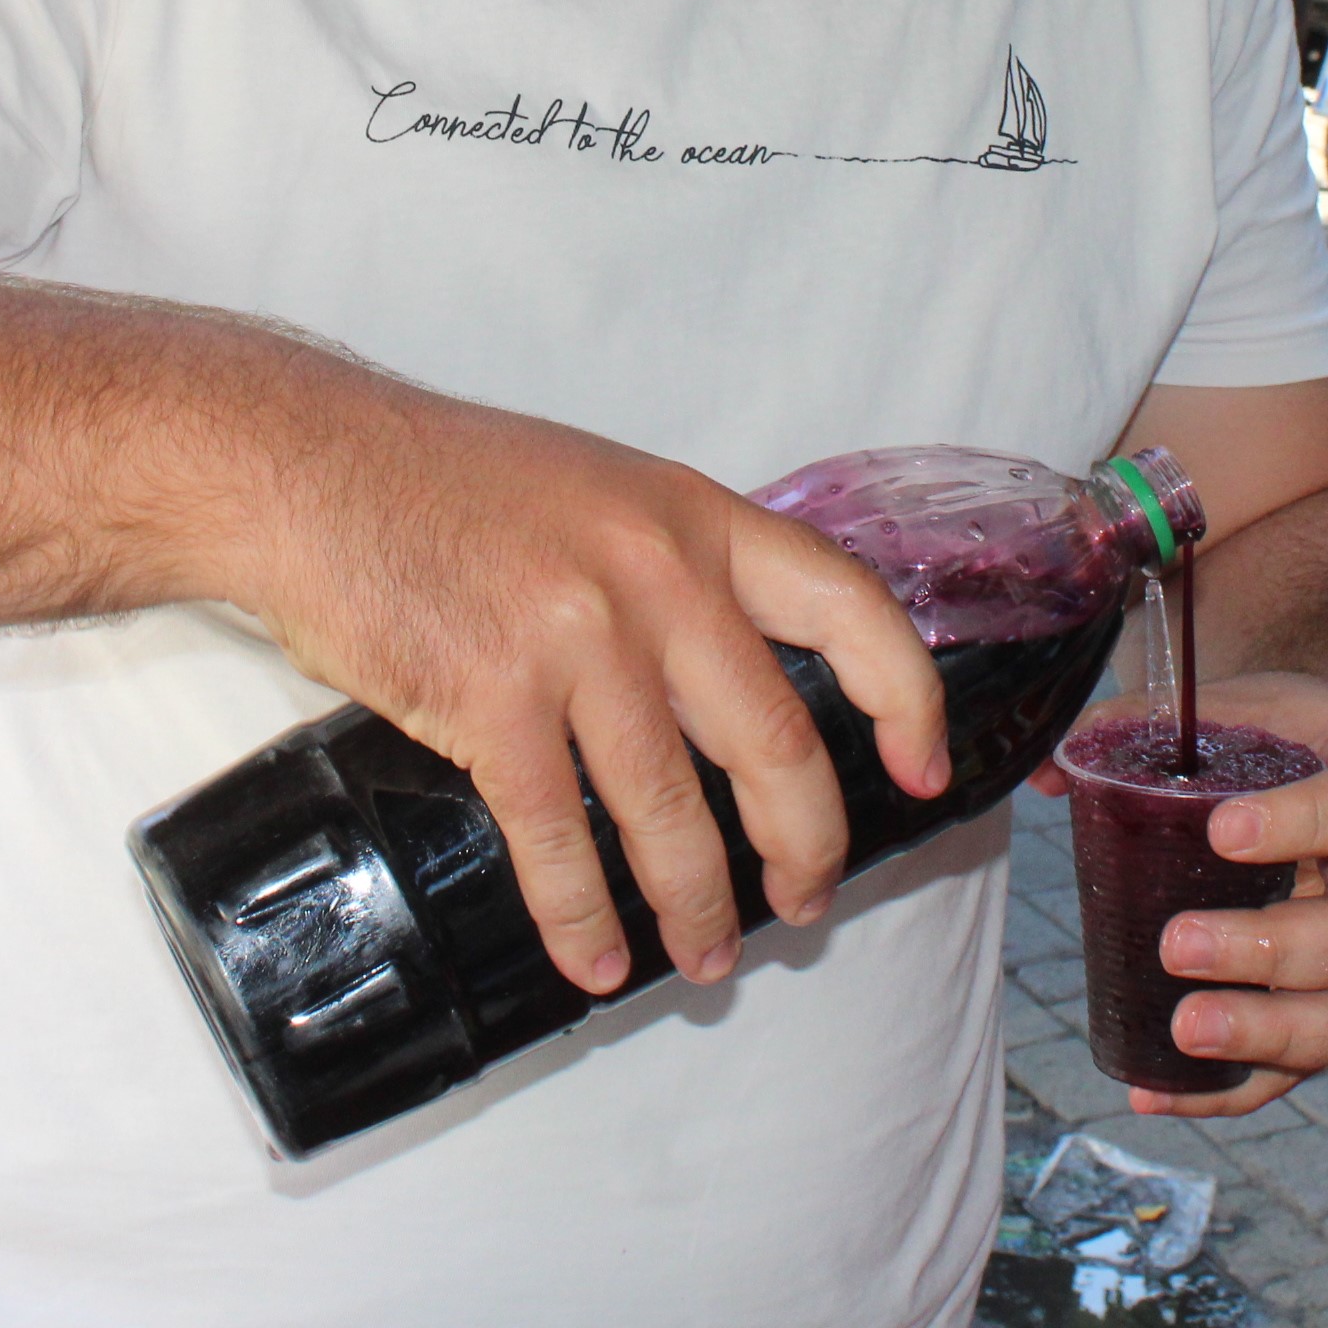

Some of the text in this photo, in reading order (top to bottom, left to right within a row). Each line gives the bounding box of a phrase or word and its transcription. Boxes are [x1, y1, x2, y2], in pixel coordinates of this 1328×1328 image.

[366, 80, 773, 166] Connected to the ocean
